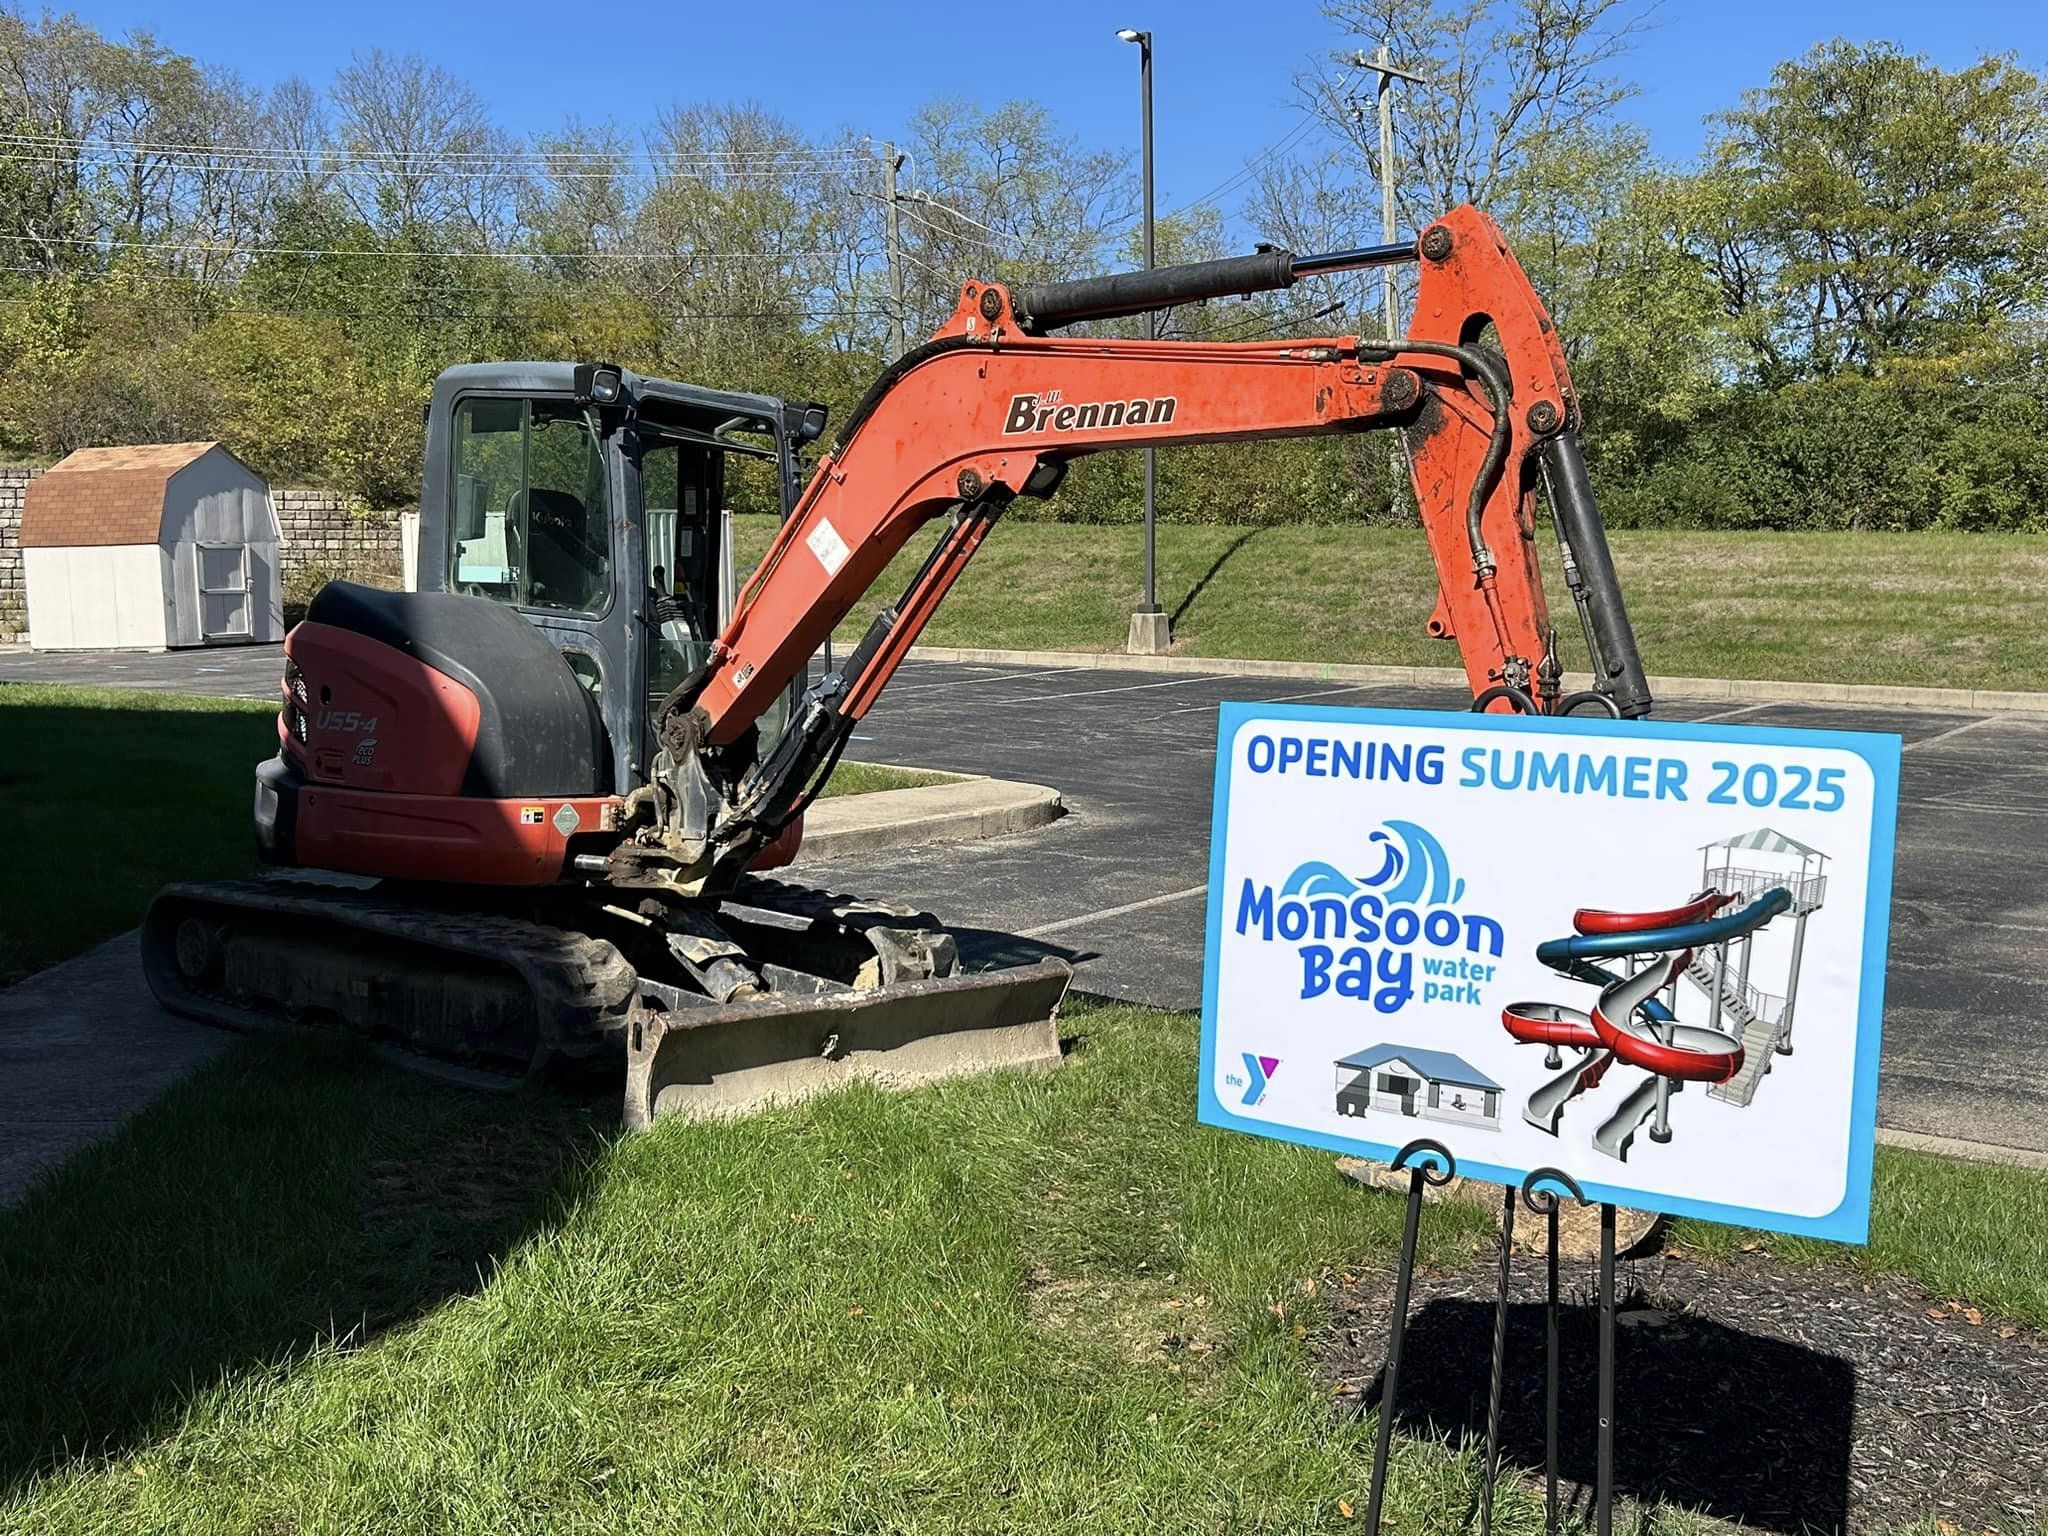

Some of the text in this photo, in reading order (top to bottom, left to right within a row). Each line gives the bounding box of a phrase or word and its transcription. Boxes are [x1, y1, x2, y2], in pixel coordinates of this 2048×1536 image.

[1003, 394, 1176, 435] Brennan
[1247, 735, 1846, 812] OPENING SUMMER 2025
[1298, 944, 1414, 1014] Bay
[1422, 957, 1496, 982] water
[1423, 982, 1481, 1005] park
[1225, 1073, 1243, 1088] the
